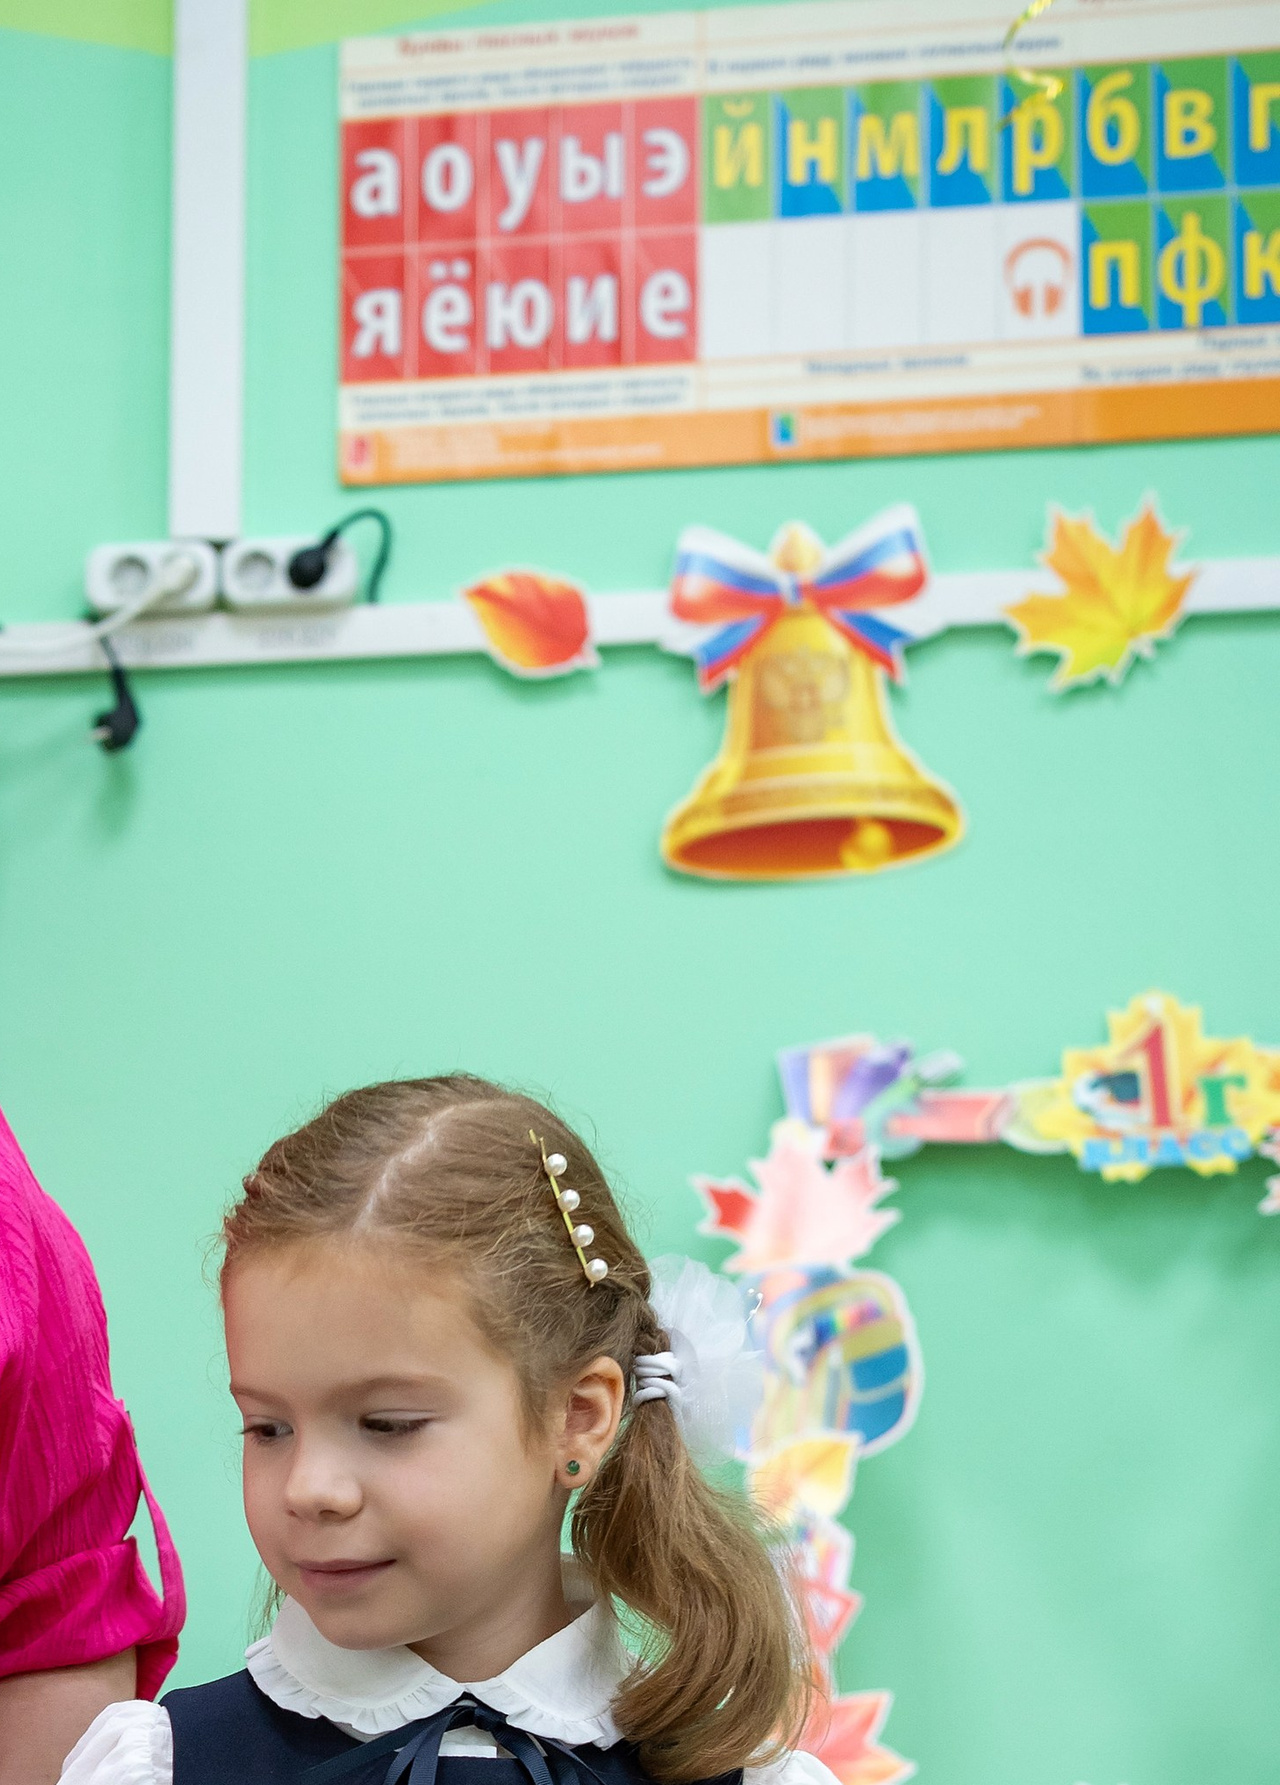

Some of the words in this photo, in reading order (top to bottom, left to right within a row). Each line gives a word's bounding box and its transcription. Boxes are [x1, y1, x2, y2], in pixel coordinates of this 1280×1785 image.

[350, 148, 402, 219] а
[422, 143, 474, 213] о
[495, 136, 545, 231] у
[558, 132, 626, 203] ы
[641, 127, 690, 198] э
[714, 99, 763, 188] й
[787, 117, 838, 185] н
[855, 112, 919, 181] м
[936, 106, 989, 174] л
[1087, 70, 1141, 166] б
[1163, 87, 1218, 160] в
[350, 287, 402, 359] я
[422, 258, 474, 354] ё
[485, 278, 555, 351] ю
[566, 273, 618, 345] и
[640, 268, 692, 339] е
[1089, 238, 1141, 311] п
[1157, 211, 1227, 327] ф
[1117, 1022, 1172, 1129] 1
